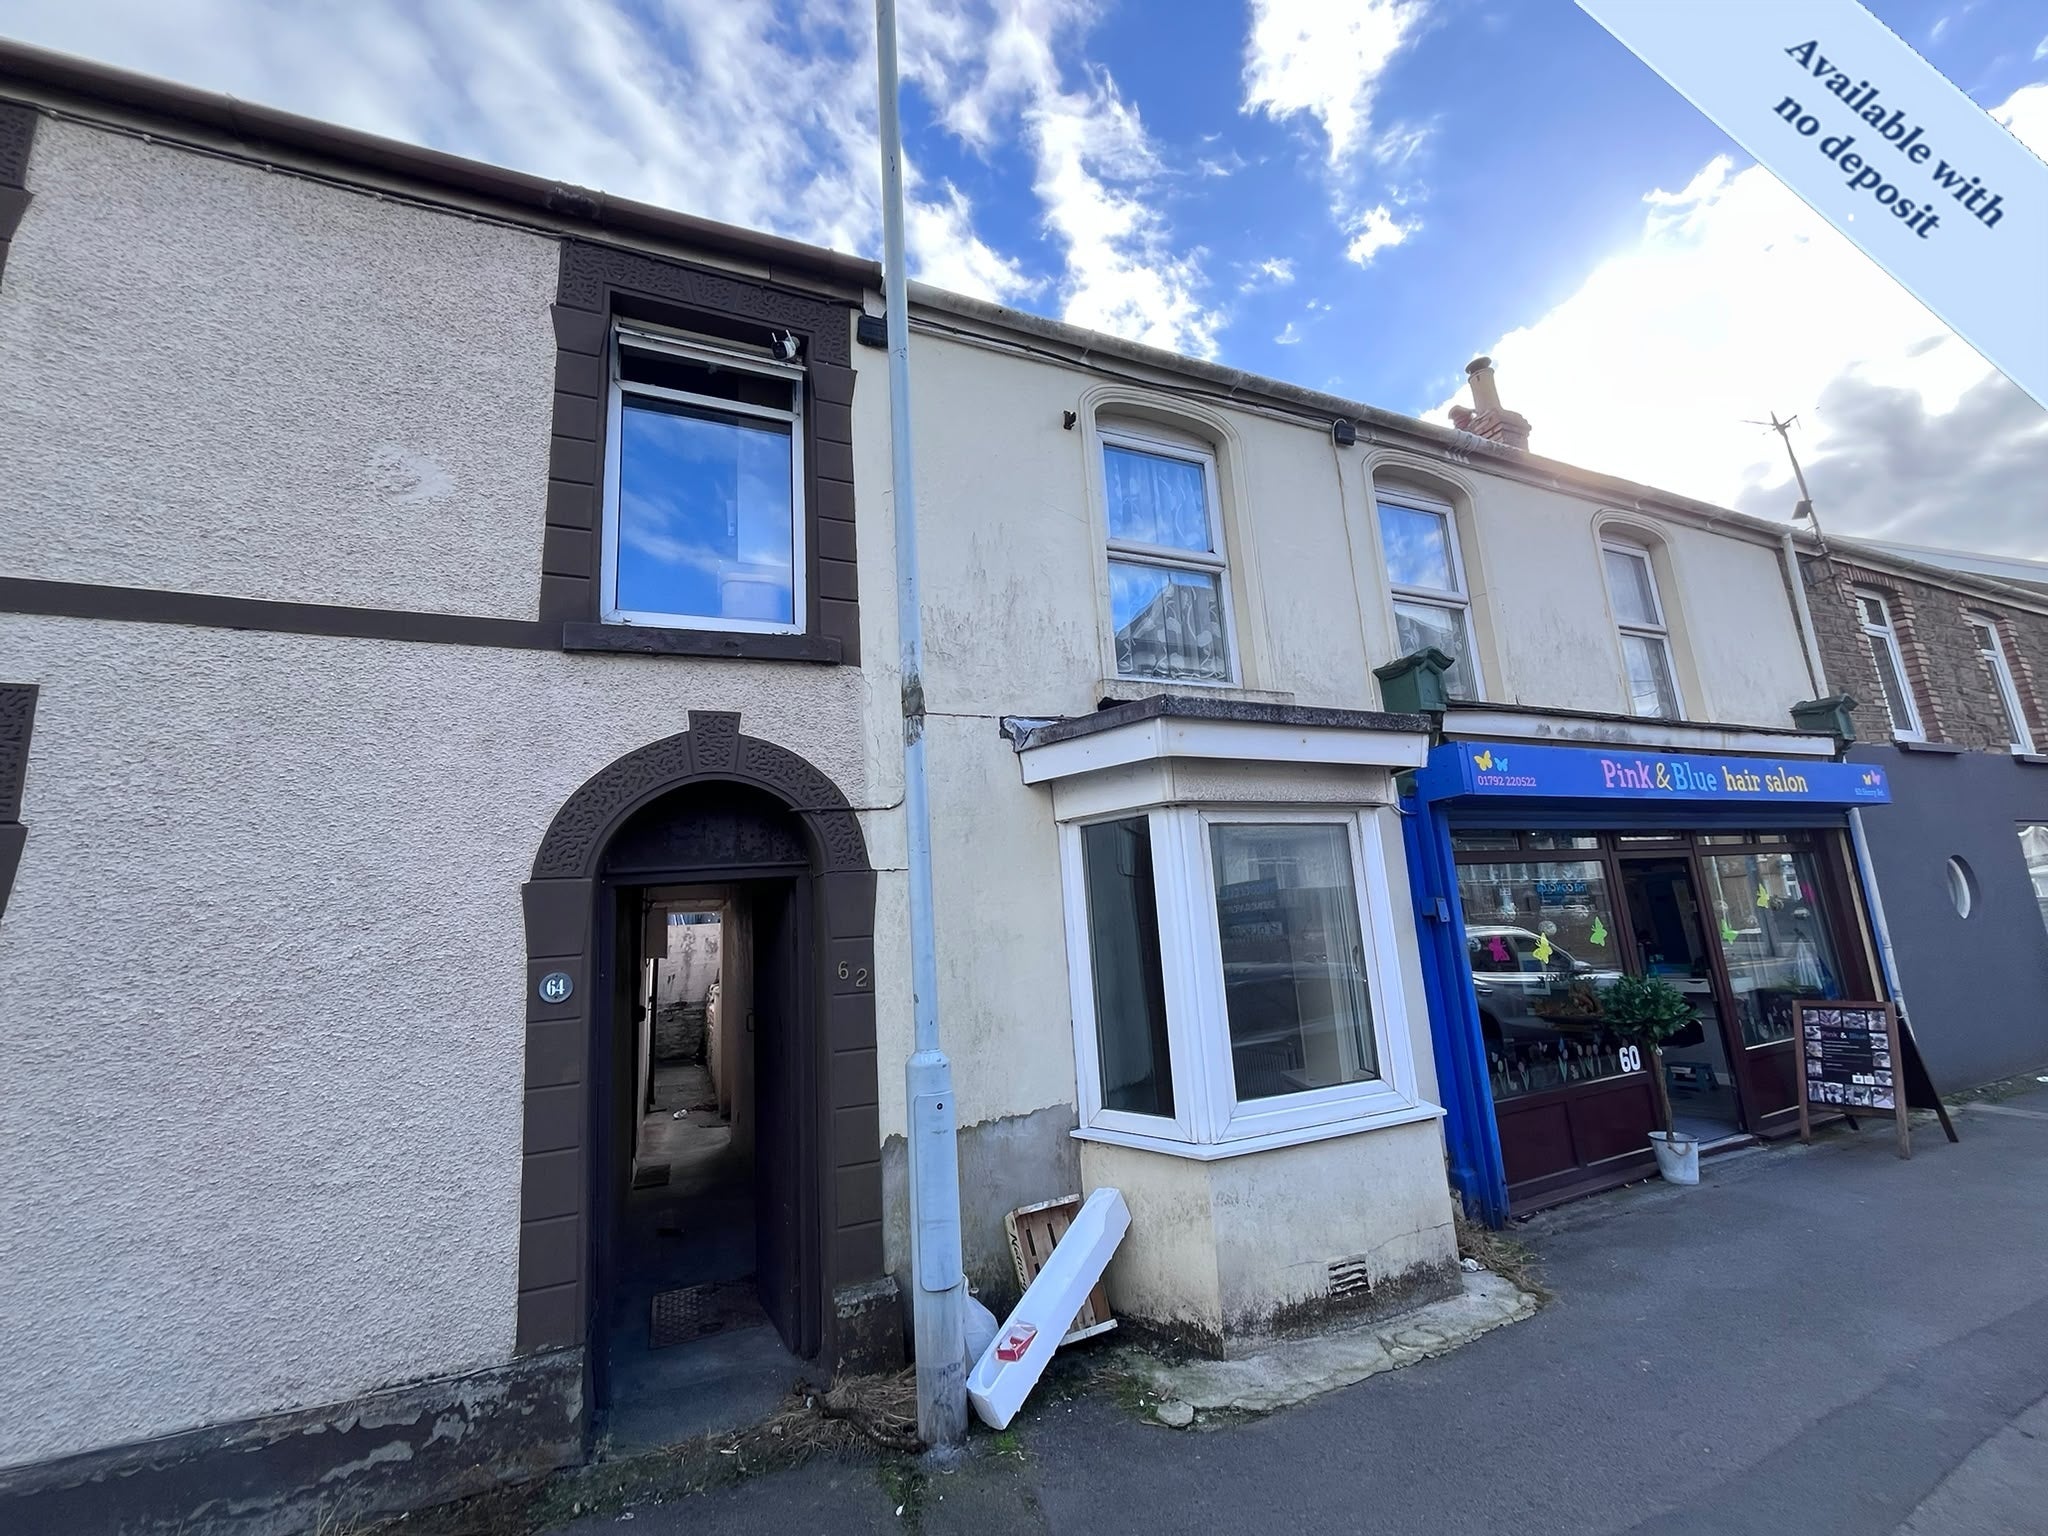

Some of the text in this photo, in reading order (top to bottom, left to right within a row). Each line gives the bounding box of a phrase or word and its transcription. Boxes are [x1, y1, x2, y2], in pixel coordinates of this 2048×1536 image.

[1477, 775, 1537, 787] 01792 220522
[1721, 766, 1760, 792] hair
[1765, 767, 1809, 793] salon
[546, 978, 566, 996] 64
[1619, 1045, 1641, 1072] 60
